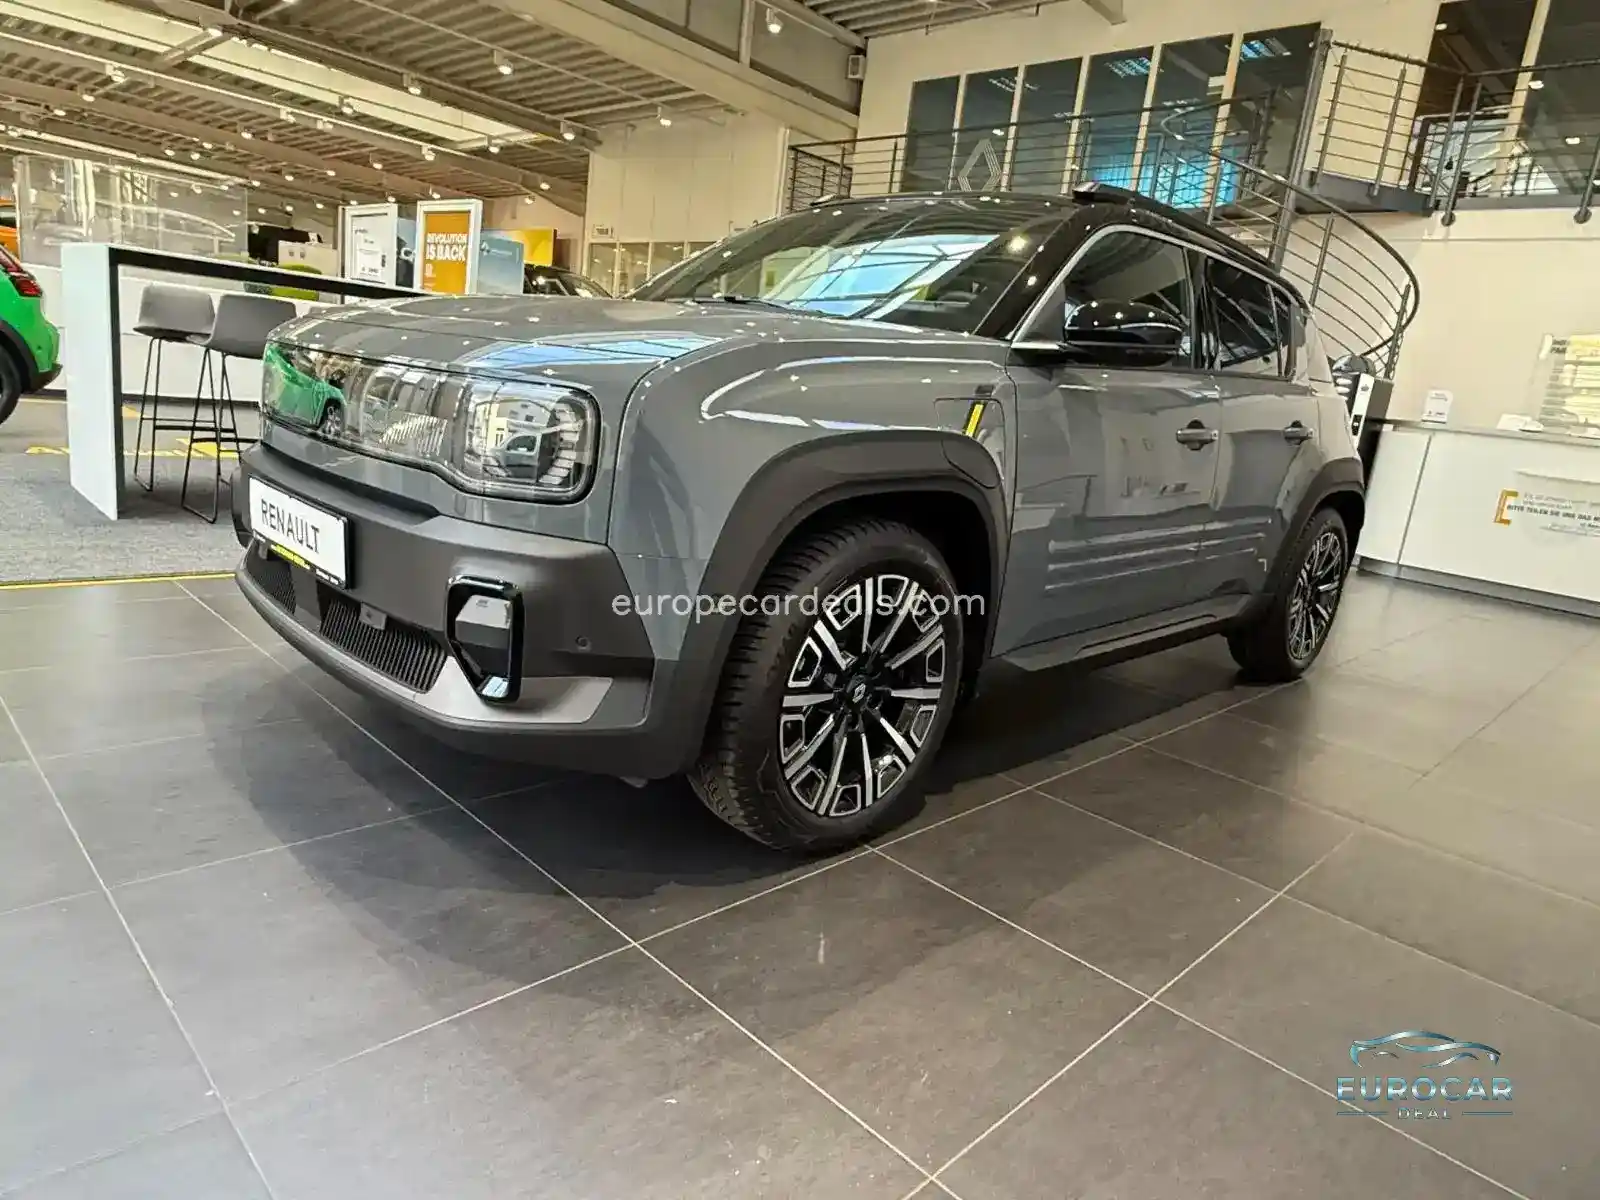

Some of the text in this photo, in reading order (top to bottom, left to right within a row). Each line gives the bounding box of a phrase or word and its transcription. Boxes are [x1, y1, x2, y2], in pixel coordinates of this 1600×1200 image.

[426, 232, 467, 244] REVOLUTION
[425, 244, 436, 260] IS
[437, 244, 466, 262] BACK
[261, 499, 320, 554] RENAULT
